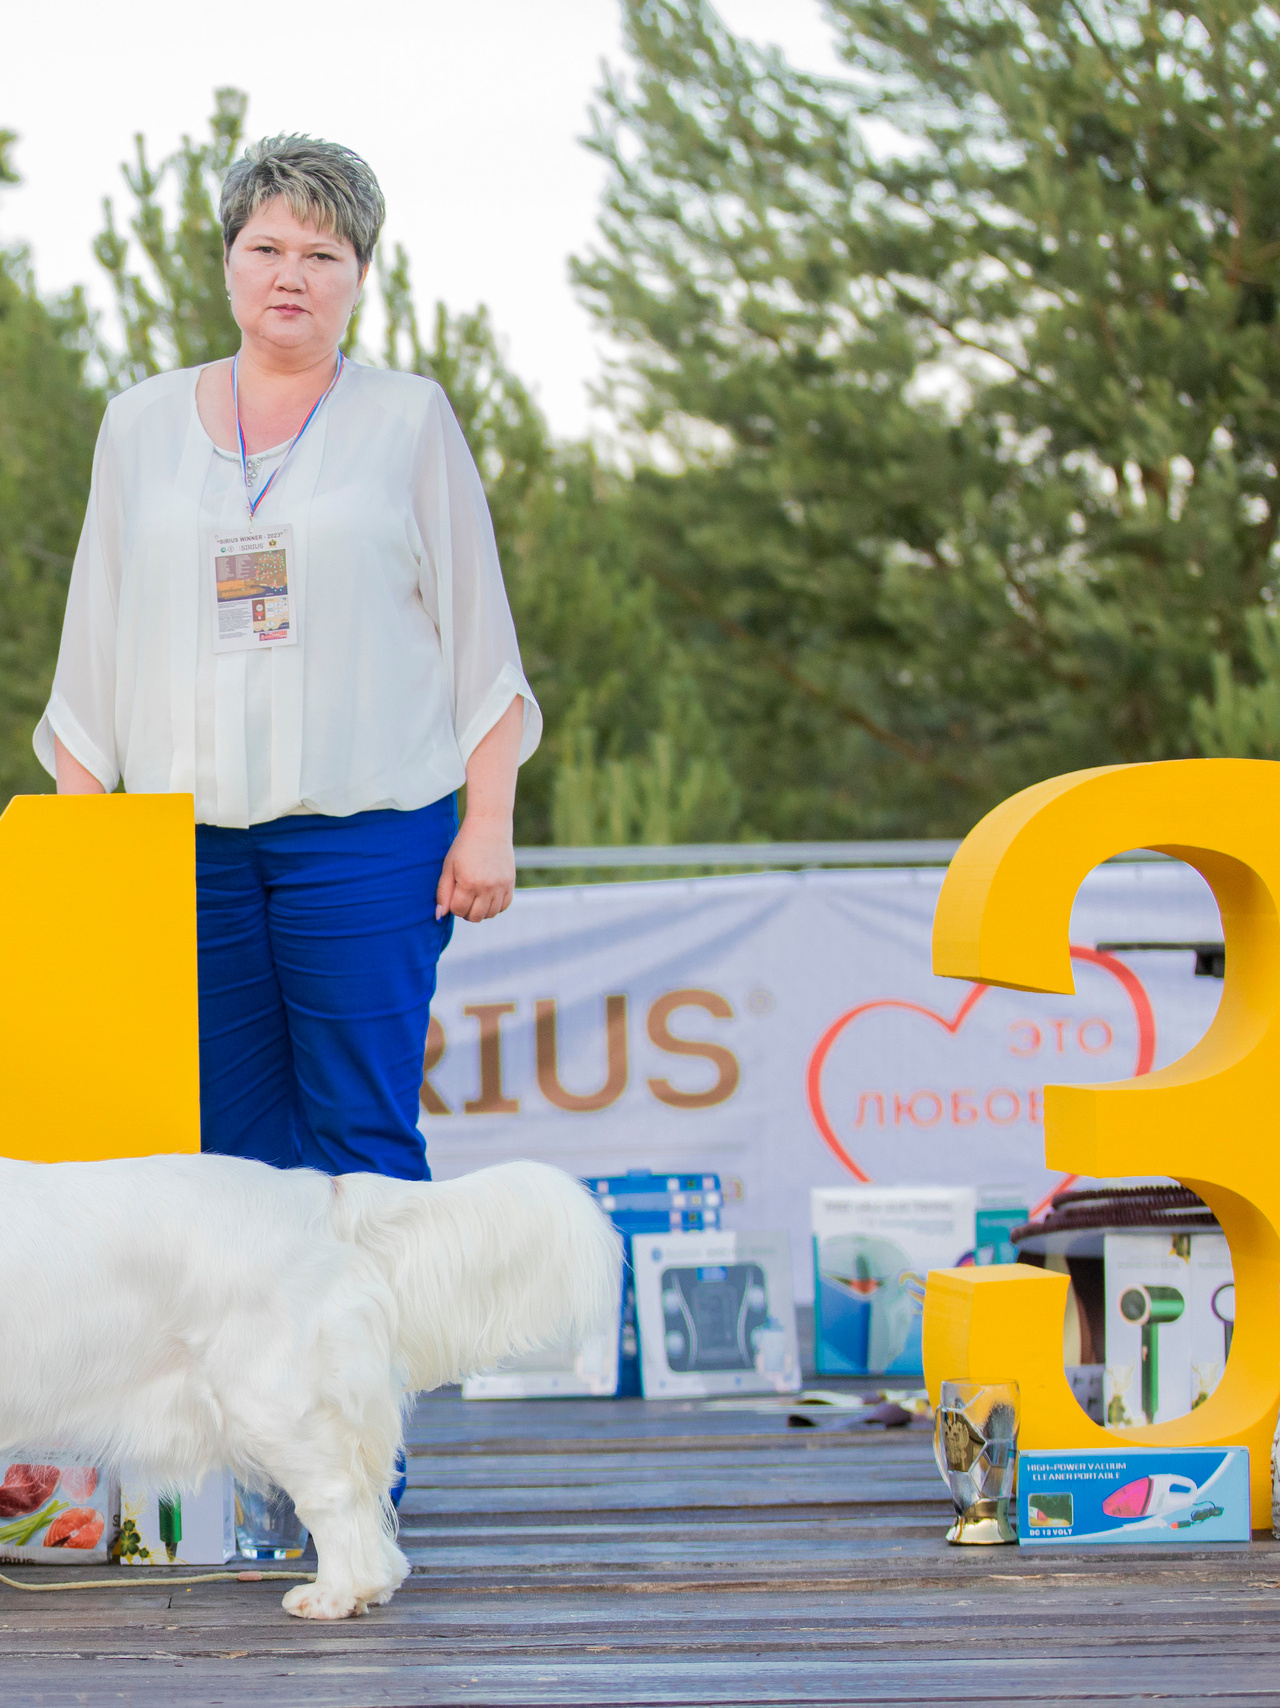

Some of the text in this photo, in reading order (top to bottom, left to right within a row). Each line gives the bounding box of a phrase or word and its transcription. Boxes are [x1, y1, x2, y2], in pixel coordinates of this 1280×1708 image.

[239, 534, 263, 542] WINNER
[240, 543, 264, 551] SIRIUS
[1008, 1017, 1114, 1057] ЭТО
[922, 758, 1280, 1449] 3
[1032, 1471, 1120, 1481] CLEANER PORTABLE
[1052, 1527, 1073, 1536] VOLT
